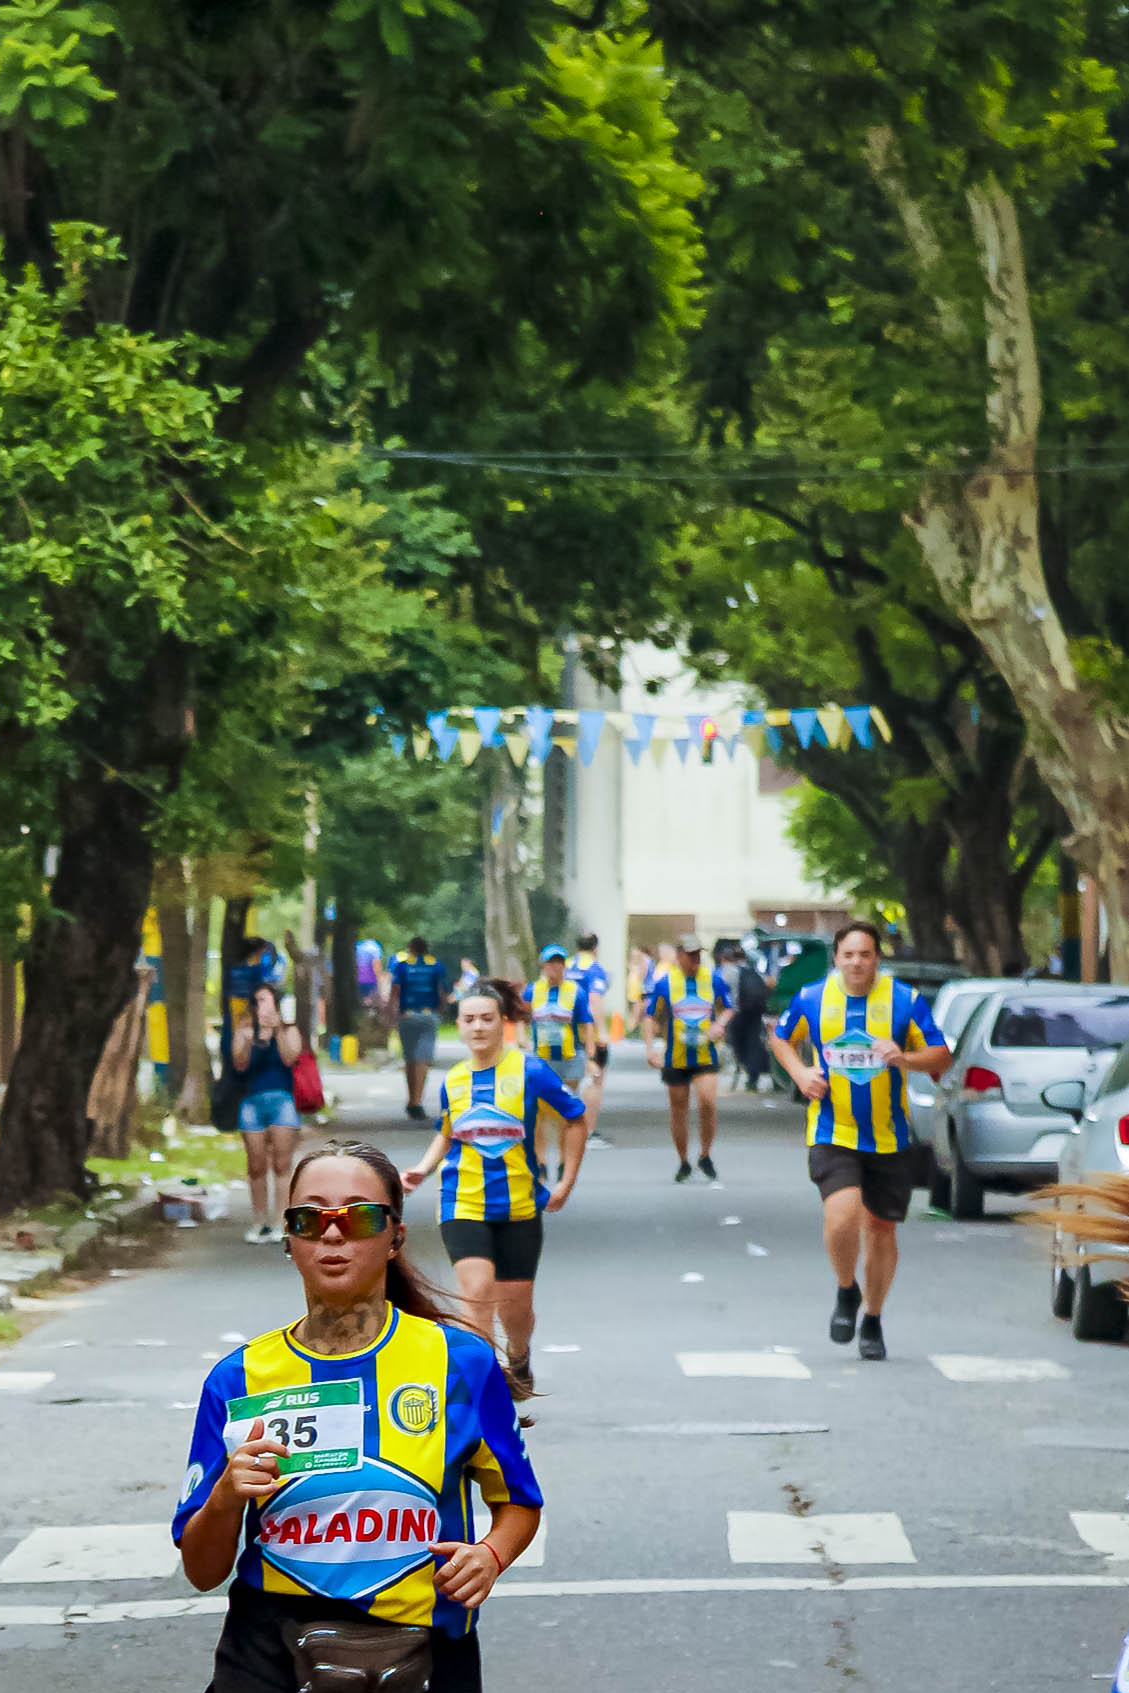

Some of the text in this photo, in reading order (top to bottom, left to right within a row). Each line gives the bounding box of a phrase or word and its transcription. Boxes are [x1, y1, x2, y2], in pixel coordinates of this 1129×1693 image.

[286, 1391, 320, 1406] RUS
[268, 1415, 318, 1448] 35
[259, 1508, 437, 1545] PALADINI
